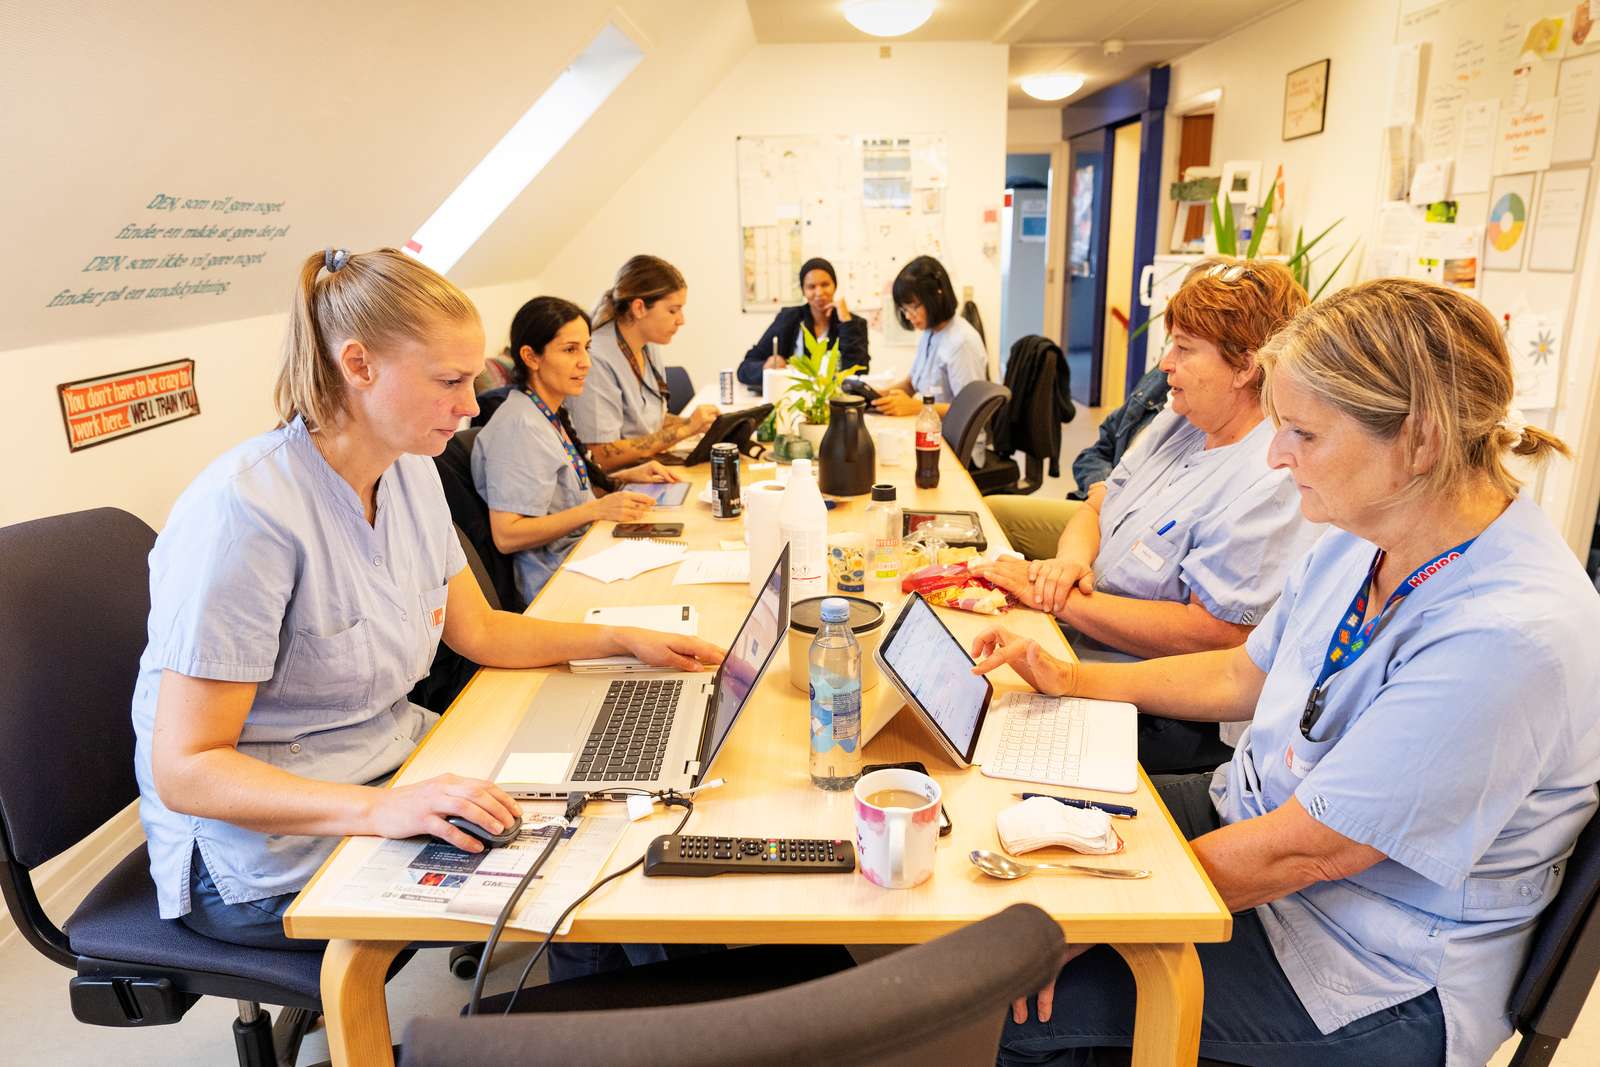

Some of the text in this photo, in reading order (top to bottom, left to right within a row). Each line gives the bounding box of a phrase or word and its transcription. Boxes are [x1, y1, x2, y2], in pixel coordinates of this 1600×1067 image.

[114, 223, 162, 240] finder
[46, 287, 102, 308] finder
[65, 389, 86, 414] You
[112, 382, 136, 403] have
[135, 379, 147, 397] to
[146, 375, 159, 394] be
[159, 372, 180, 392] crazy
[179, 369, 190, 388] to
[72, 415, 102, 442] work
[156, 393, 180, 417] TRAIN
